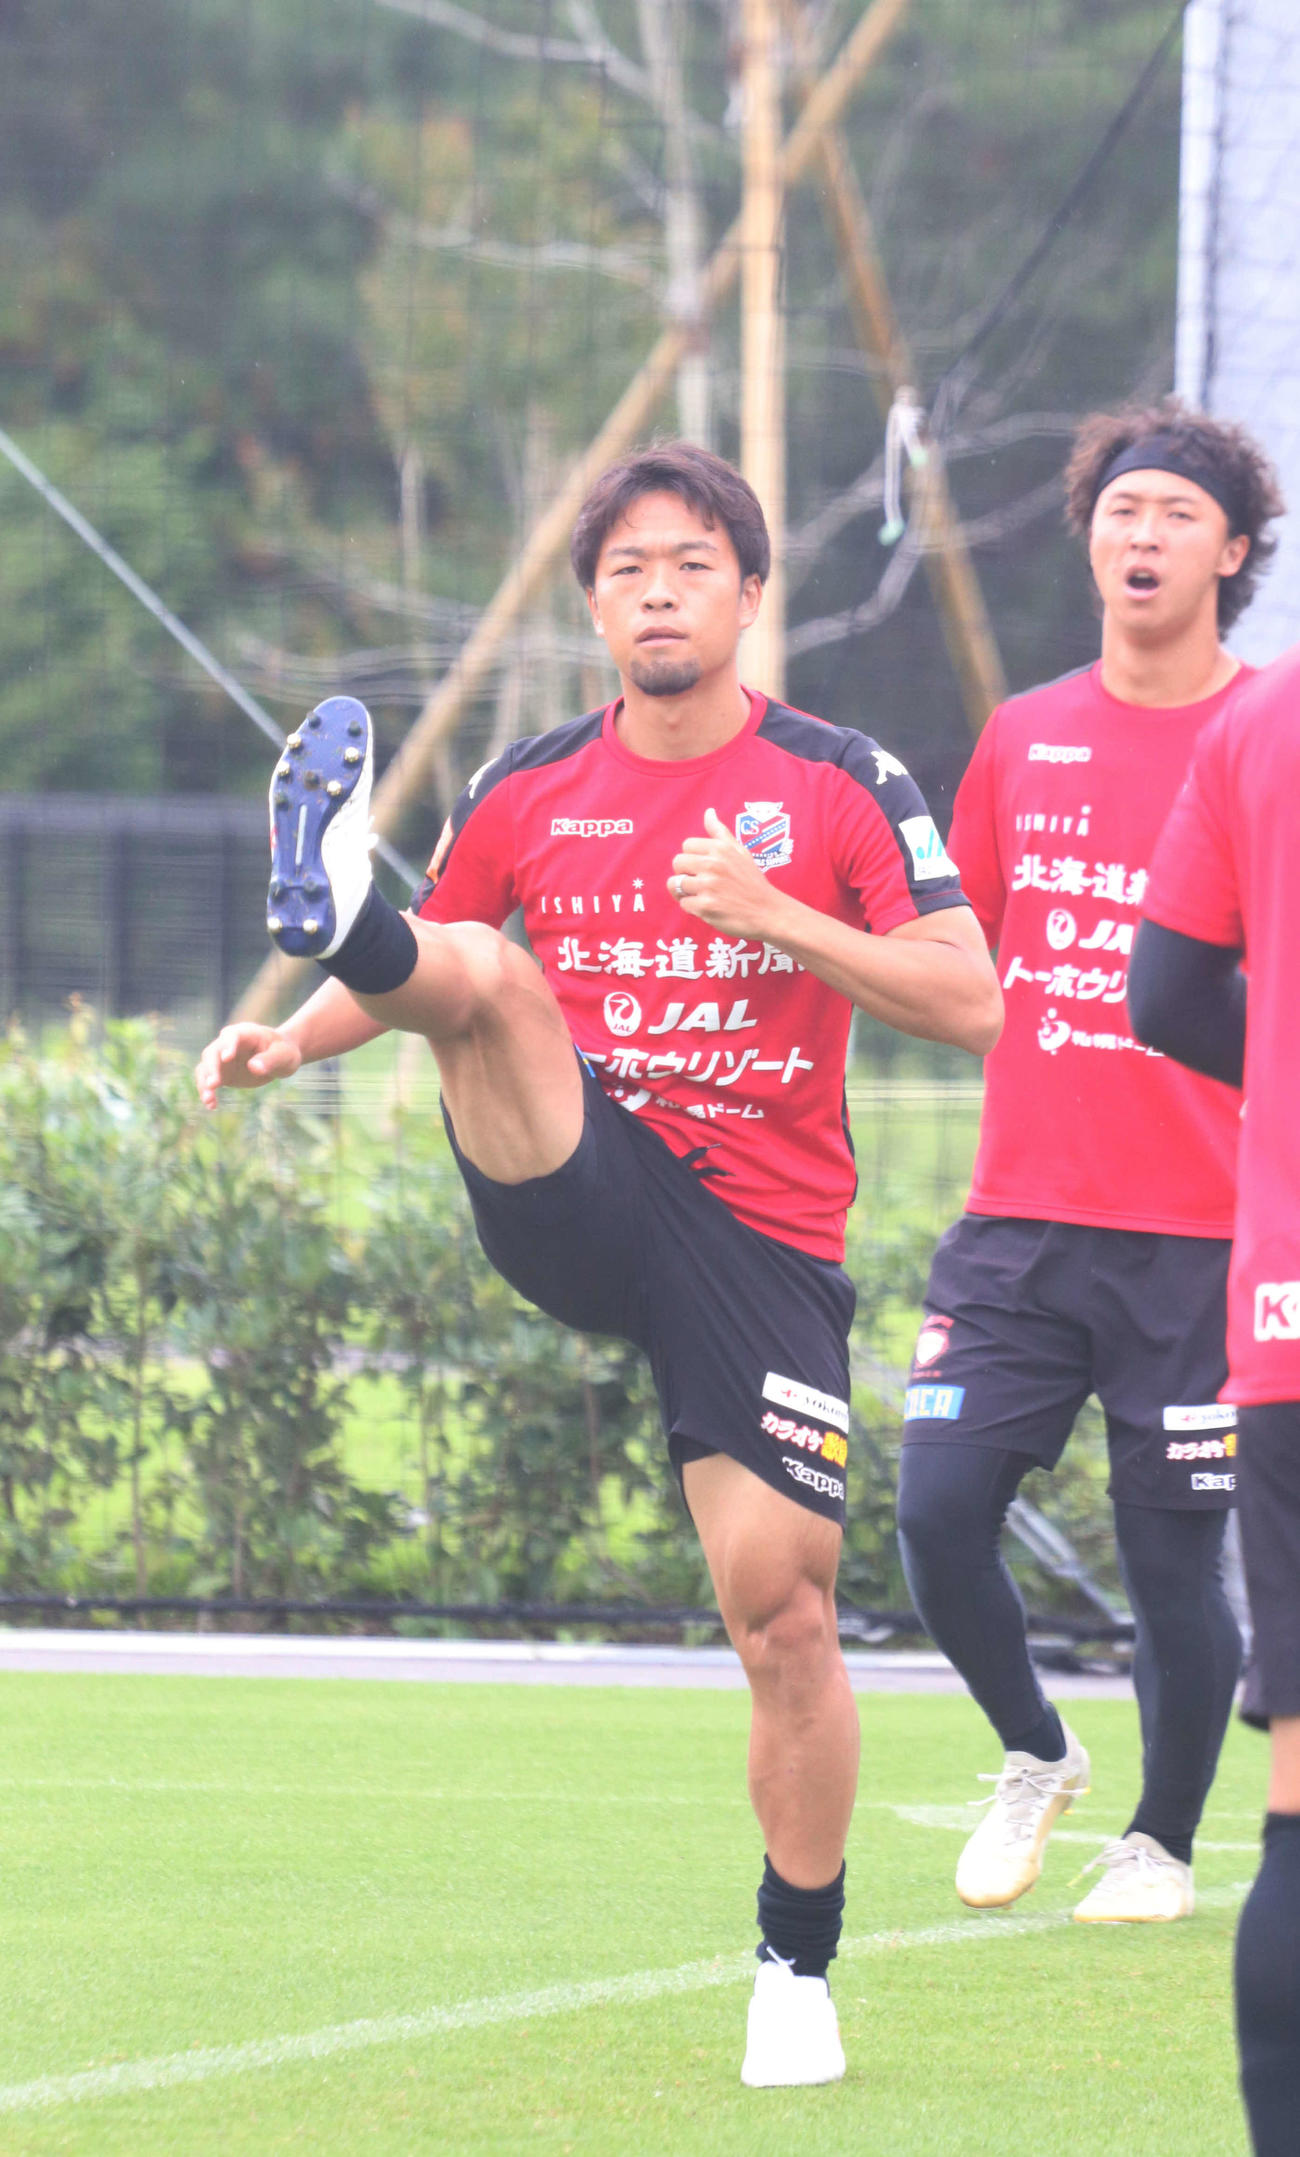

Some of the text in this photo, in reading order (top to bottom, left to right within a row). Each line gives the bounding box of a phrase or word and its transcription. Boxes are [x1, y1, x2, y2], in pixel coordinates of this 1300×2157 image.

[551, 818, 634, 838] Kappa
[540, 893, 645, 914] ISHIYA
[1078, 919, 1134, 955] JA
[1003, 956, 1128, 1003] トーホウリ
[647, 999, 758, 1034] JAL
[582, 1047, 814, 1087] ーホウリゾート
